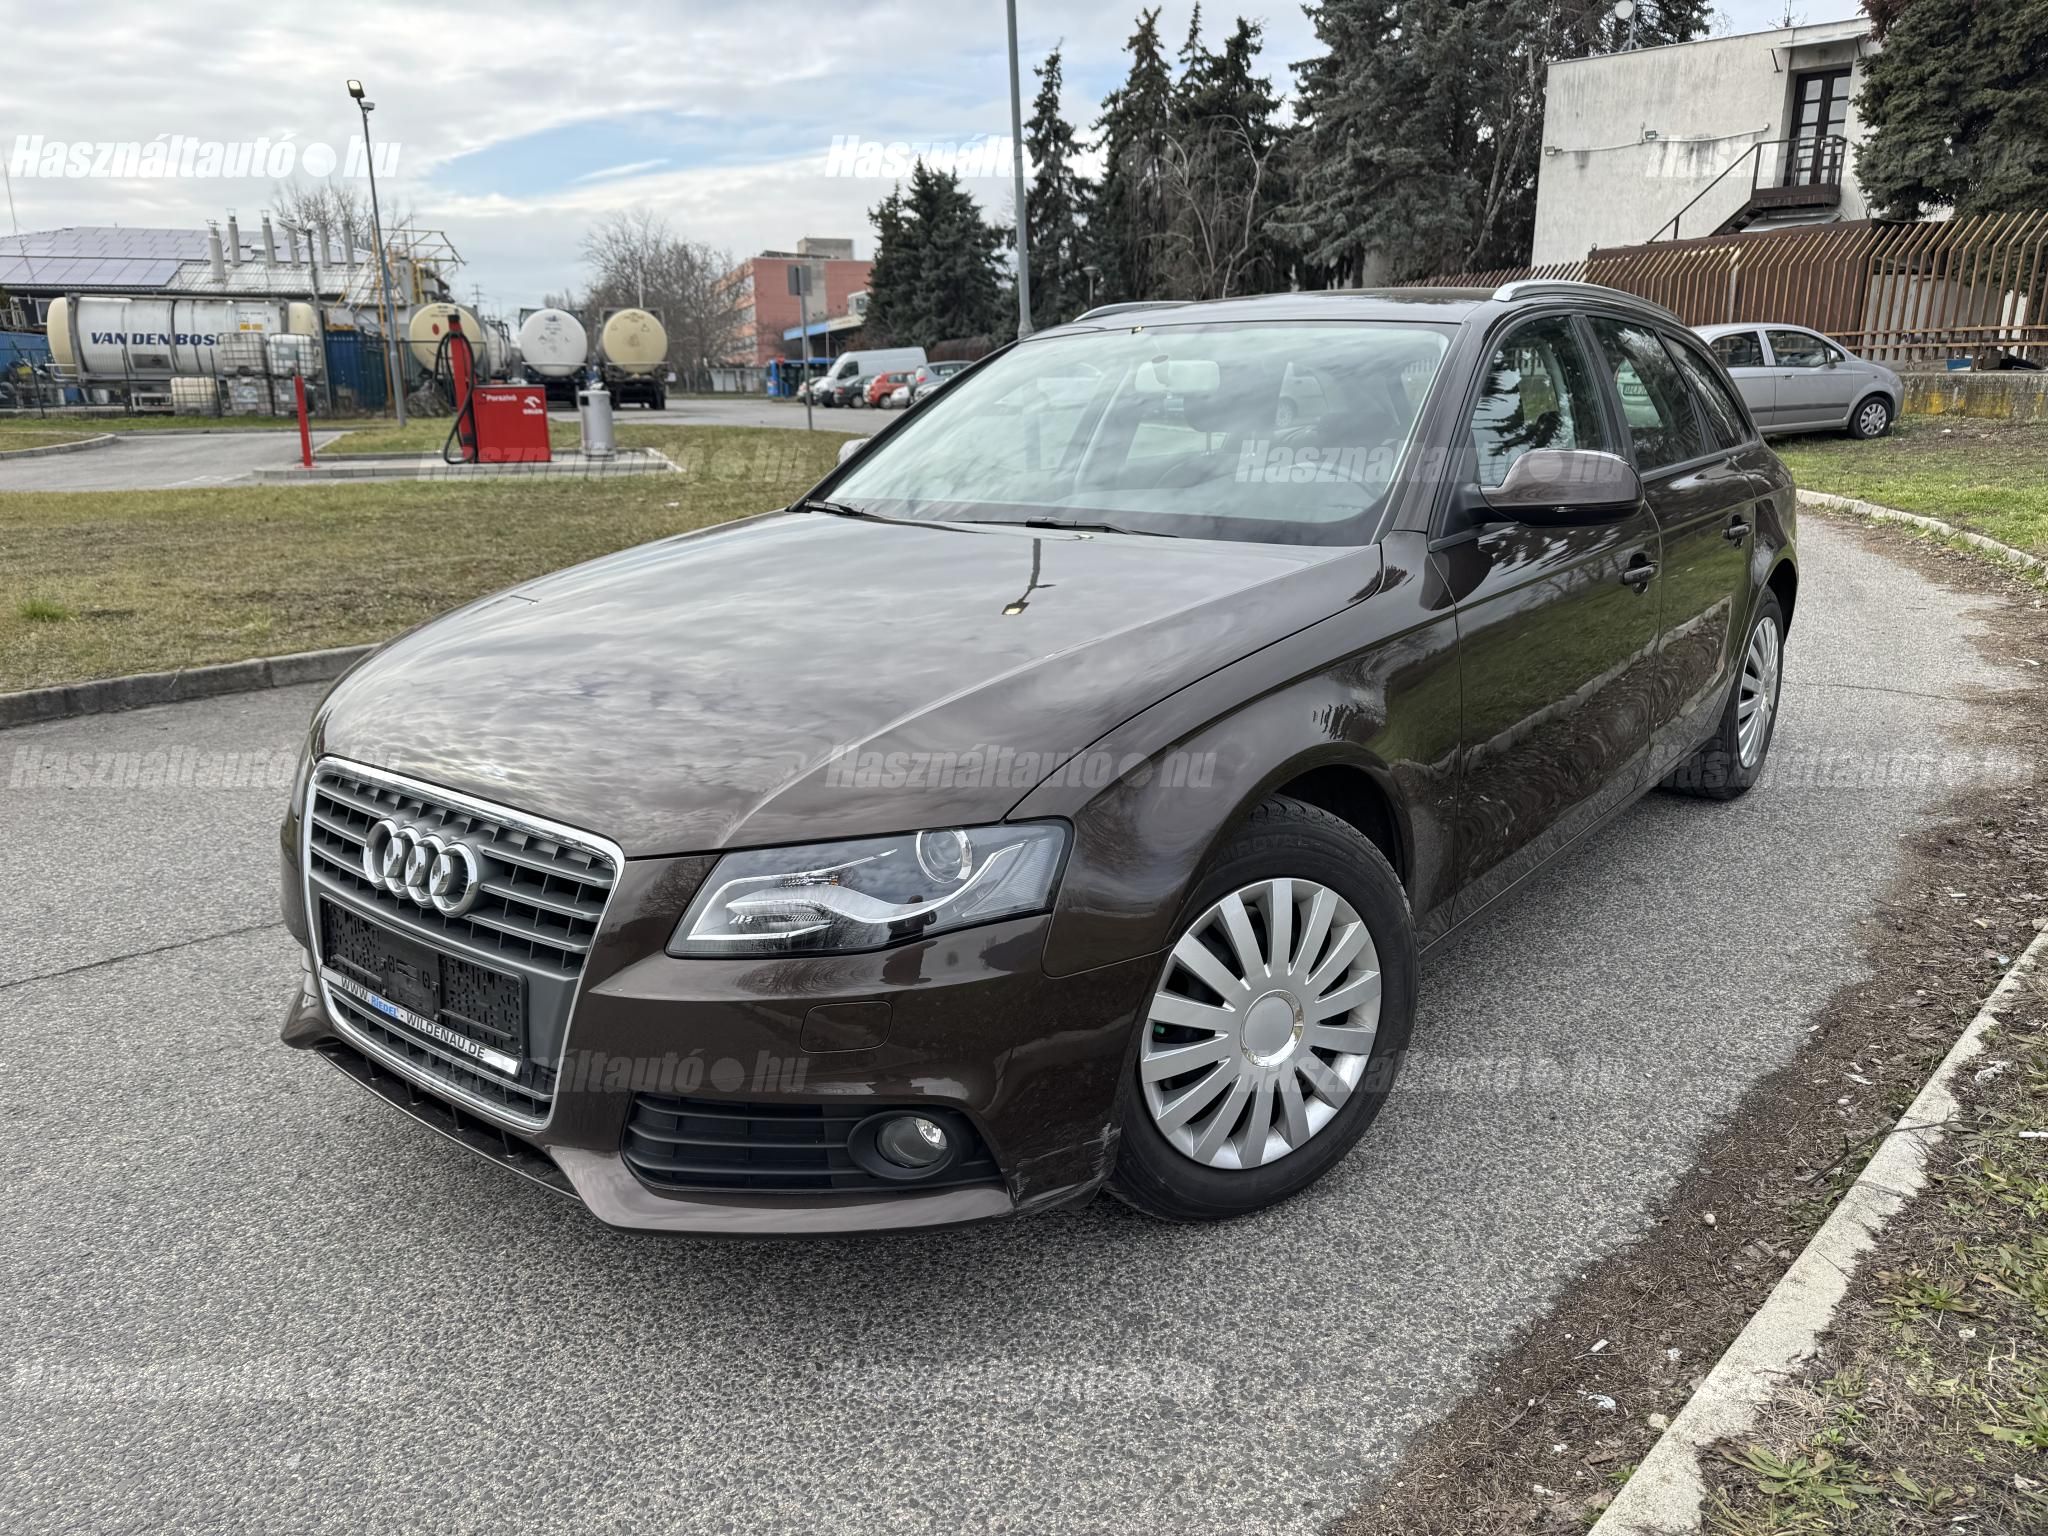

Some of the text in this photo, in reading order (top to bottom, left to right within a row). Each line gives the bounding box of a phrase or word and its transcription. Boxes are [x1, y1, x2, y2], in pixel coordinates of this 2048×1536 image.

[91, 332, 127, 345] VAN
[132, 332, 171, 346] DEN
[406, 1012, 485, 1059] WILDENAU.DE
